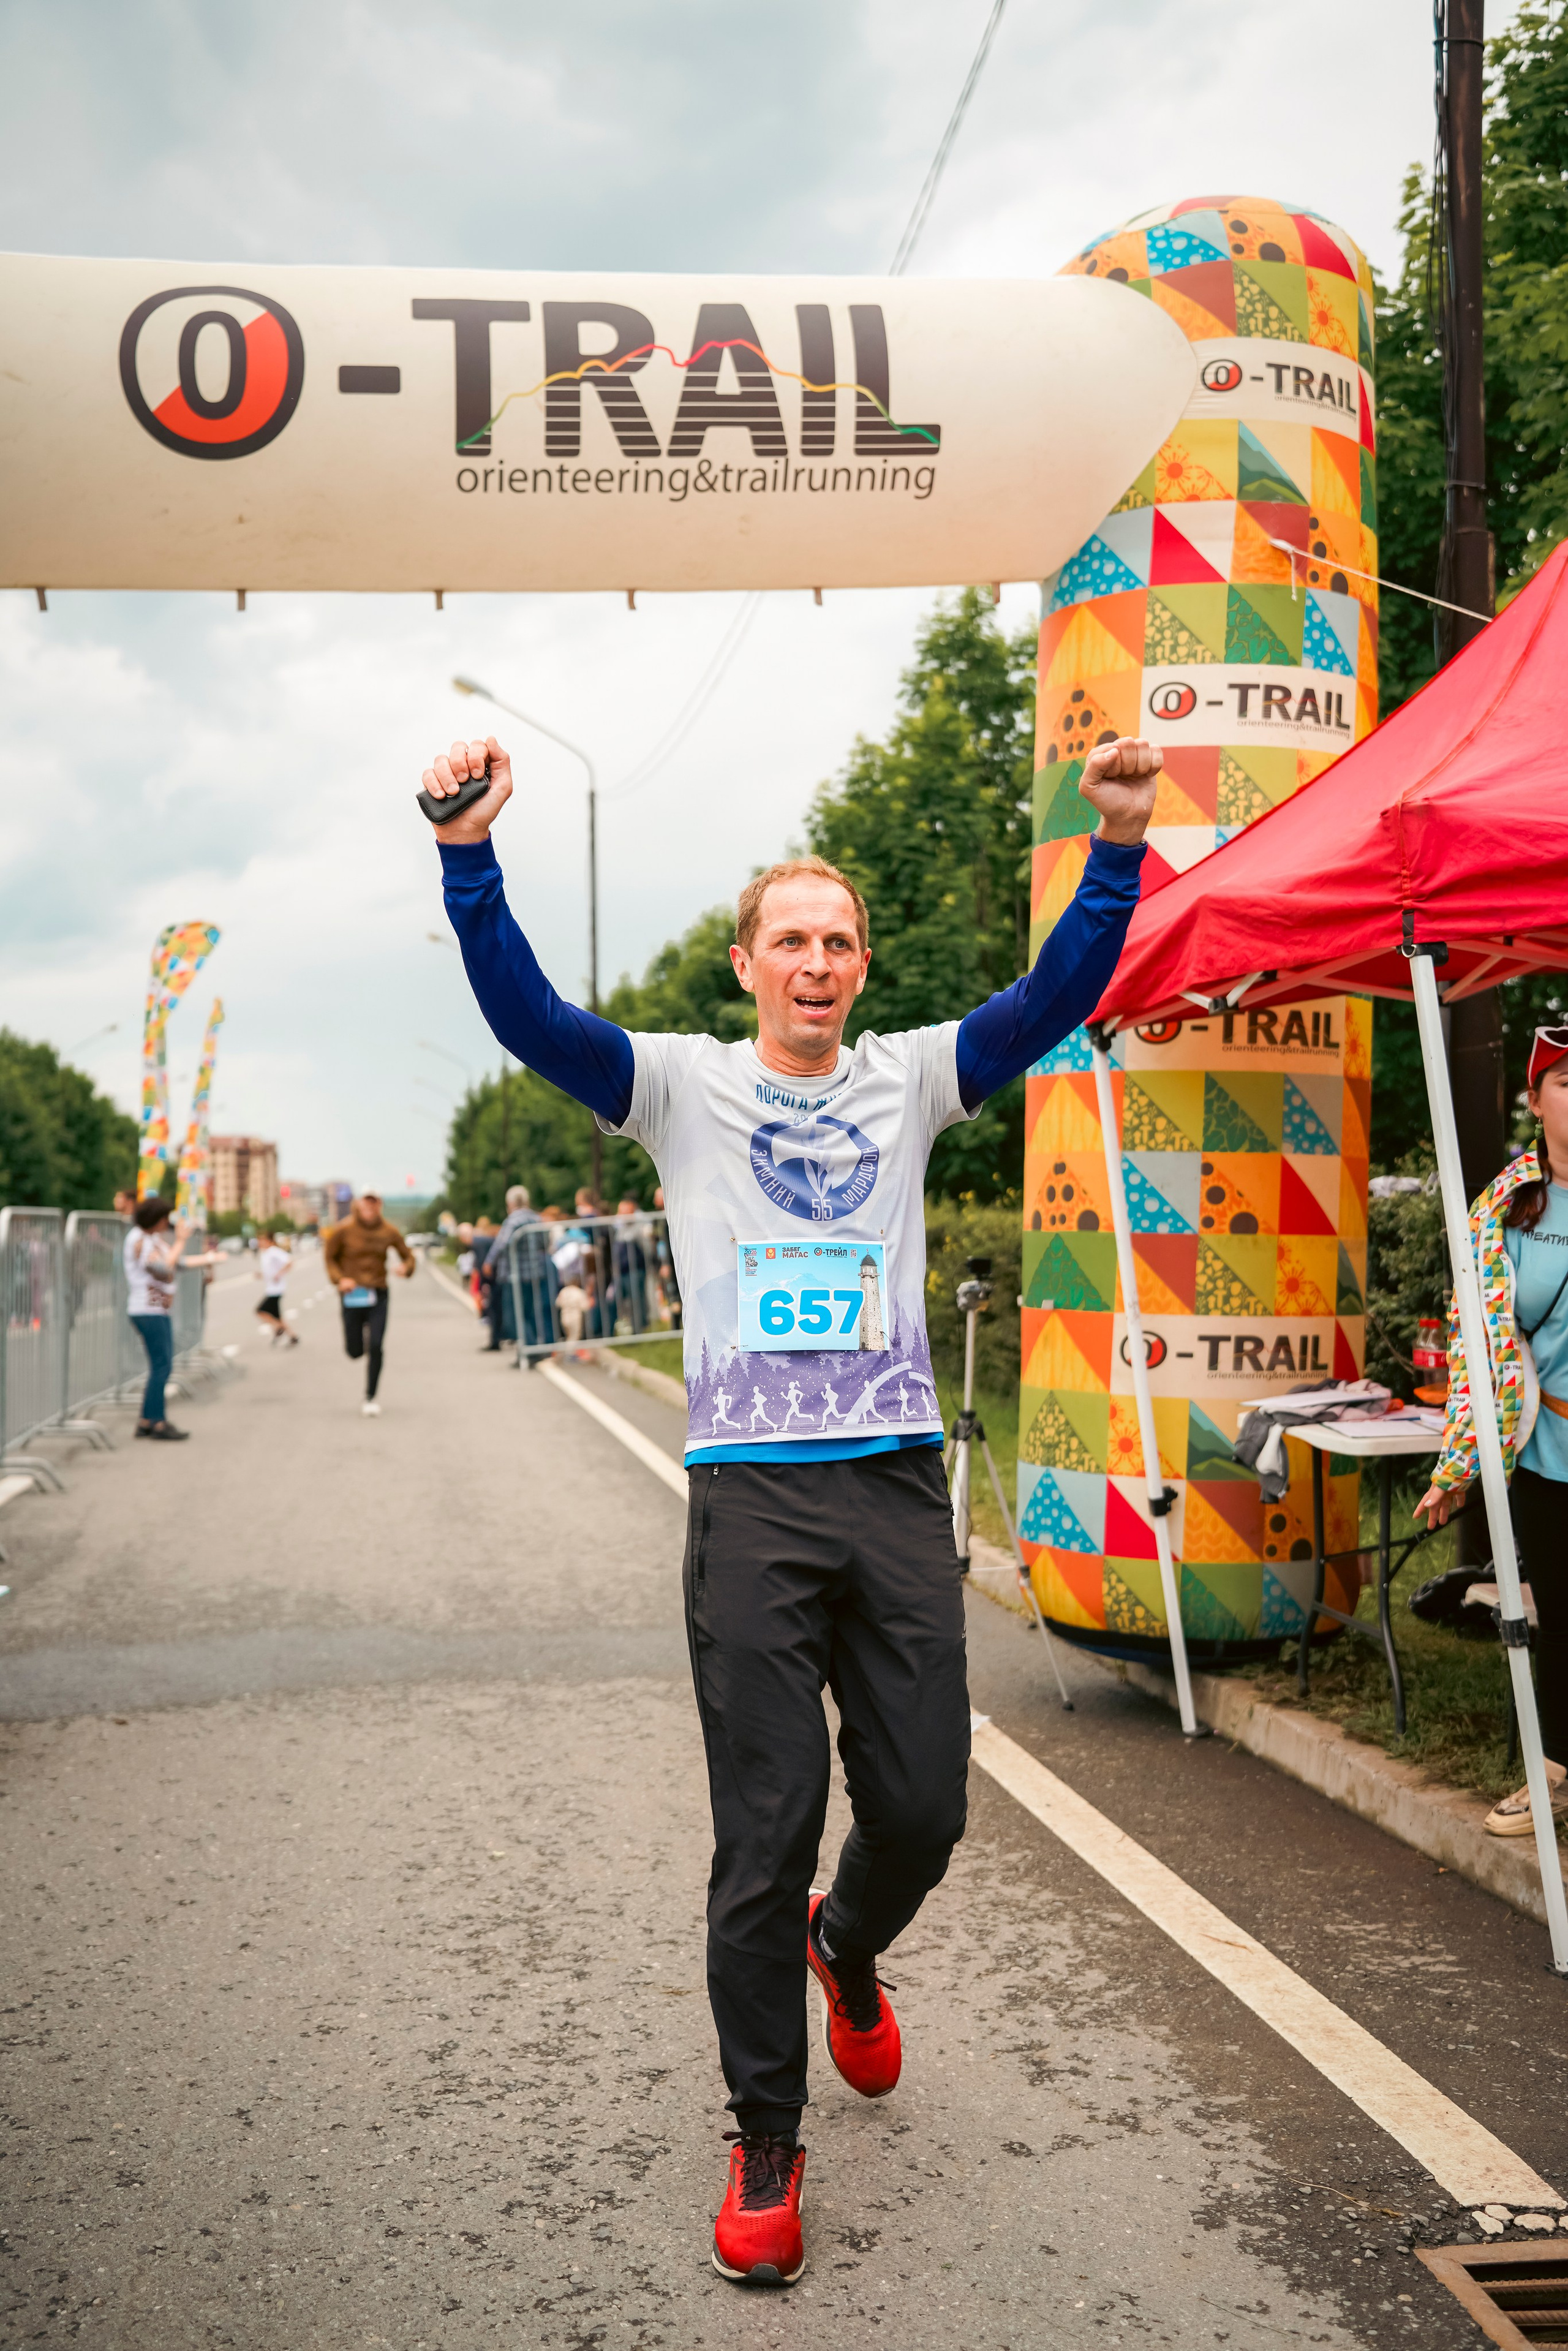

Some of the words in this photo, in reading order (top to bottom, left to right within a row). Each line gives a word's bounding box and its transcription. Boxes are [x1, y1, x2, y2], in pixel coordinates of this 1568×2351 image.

[456, 458, 937, 502] orienteering&trailrunning
[1237, 719, 1350, 739] orienteering&trailrunning
[751, 1150, 796, 1209] ЗИМНИЙ
[812, 1198, 833, 1220] 55
[842, 1145, 878, 1207] МАРАФОН
[759, 1289, 864, 1335] 657
